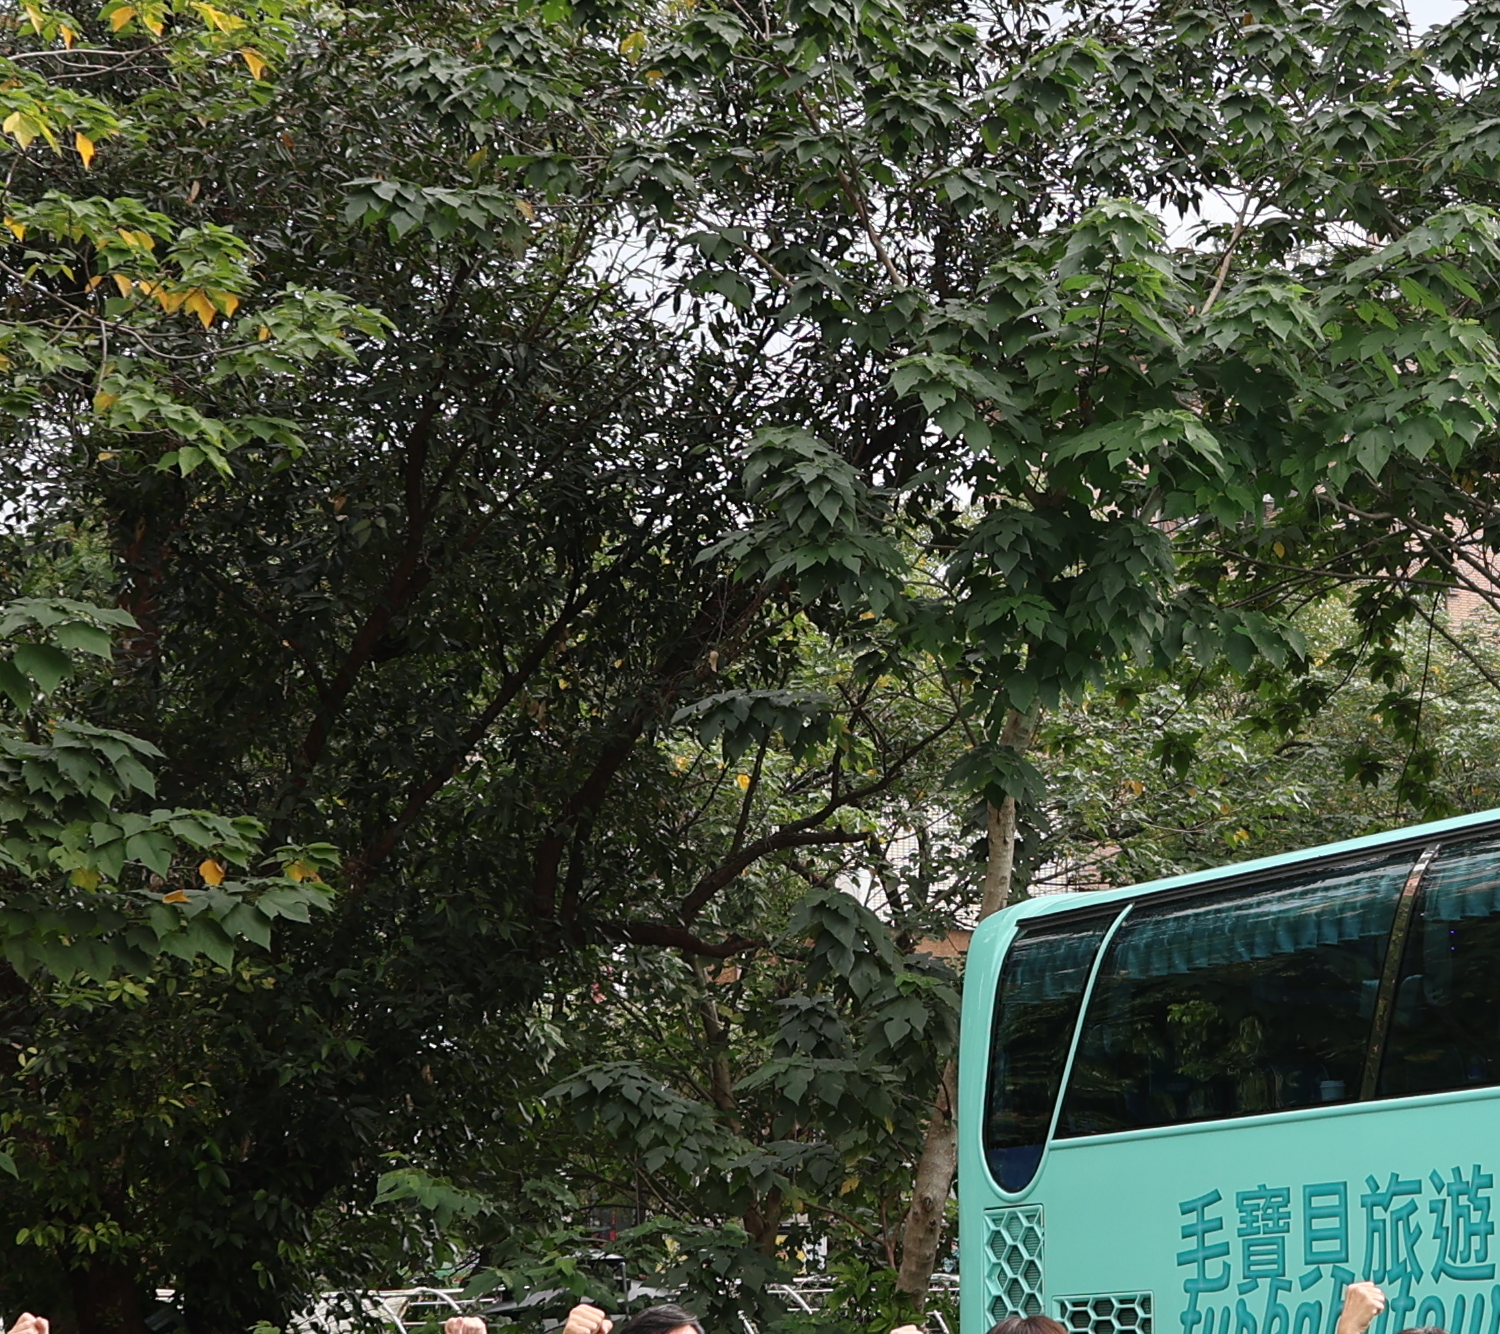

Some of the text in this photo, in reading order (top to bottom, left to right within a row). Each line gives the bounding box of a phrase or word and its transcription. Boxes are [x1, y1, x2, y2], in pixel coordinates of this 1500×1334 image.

[1176, 1164, 1496, 1295] 毛寶貝旅遊
